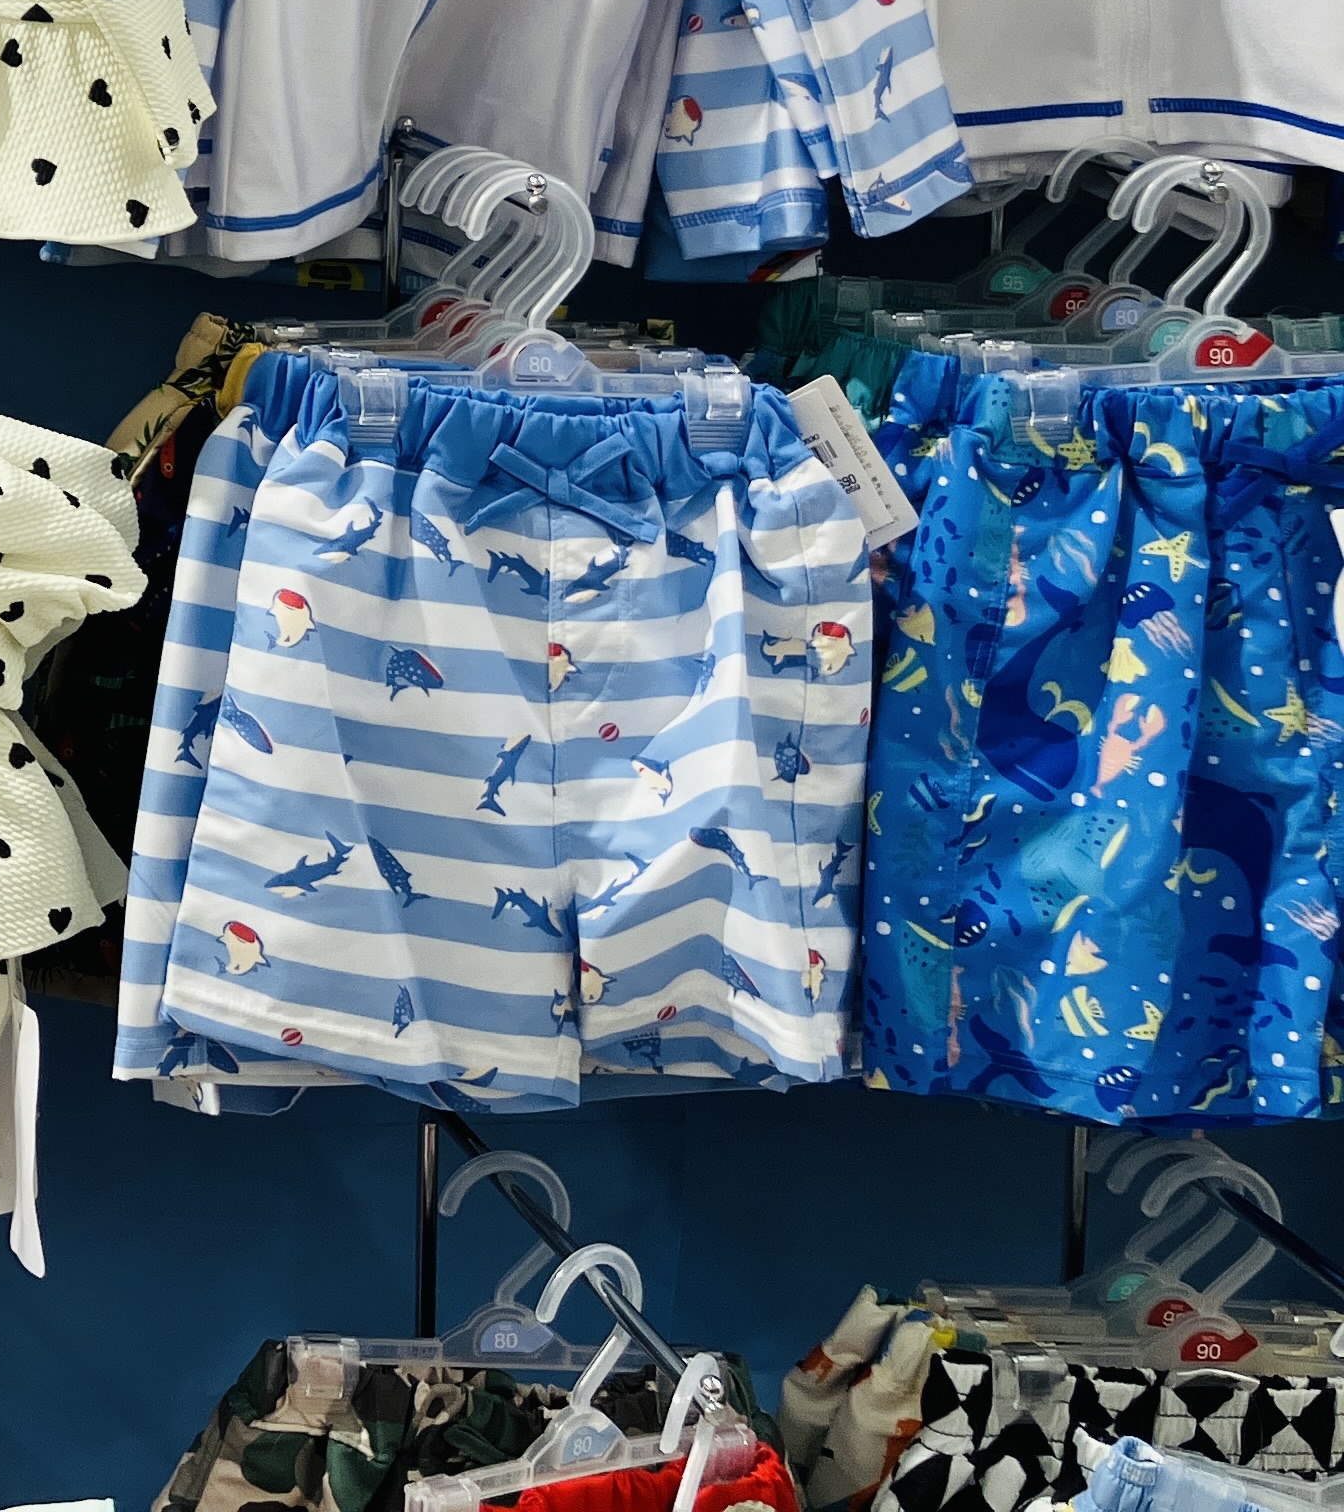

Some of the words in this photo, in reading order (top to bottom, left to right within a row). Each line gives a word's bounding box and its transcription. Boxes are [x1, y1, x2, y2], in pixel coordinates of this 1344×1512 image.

[1002, 275, 1024, 290] 95
[1115, 309, 1139, 326] 80
[529, 356, 551, 373] 80
[1209, 347, 1234, 365] 90
[494, 1332, 518, 1349] 80
[1196, 1343, 1222, 1360] 90
[572, 1436, 593, 1457] 80
